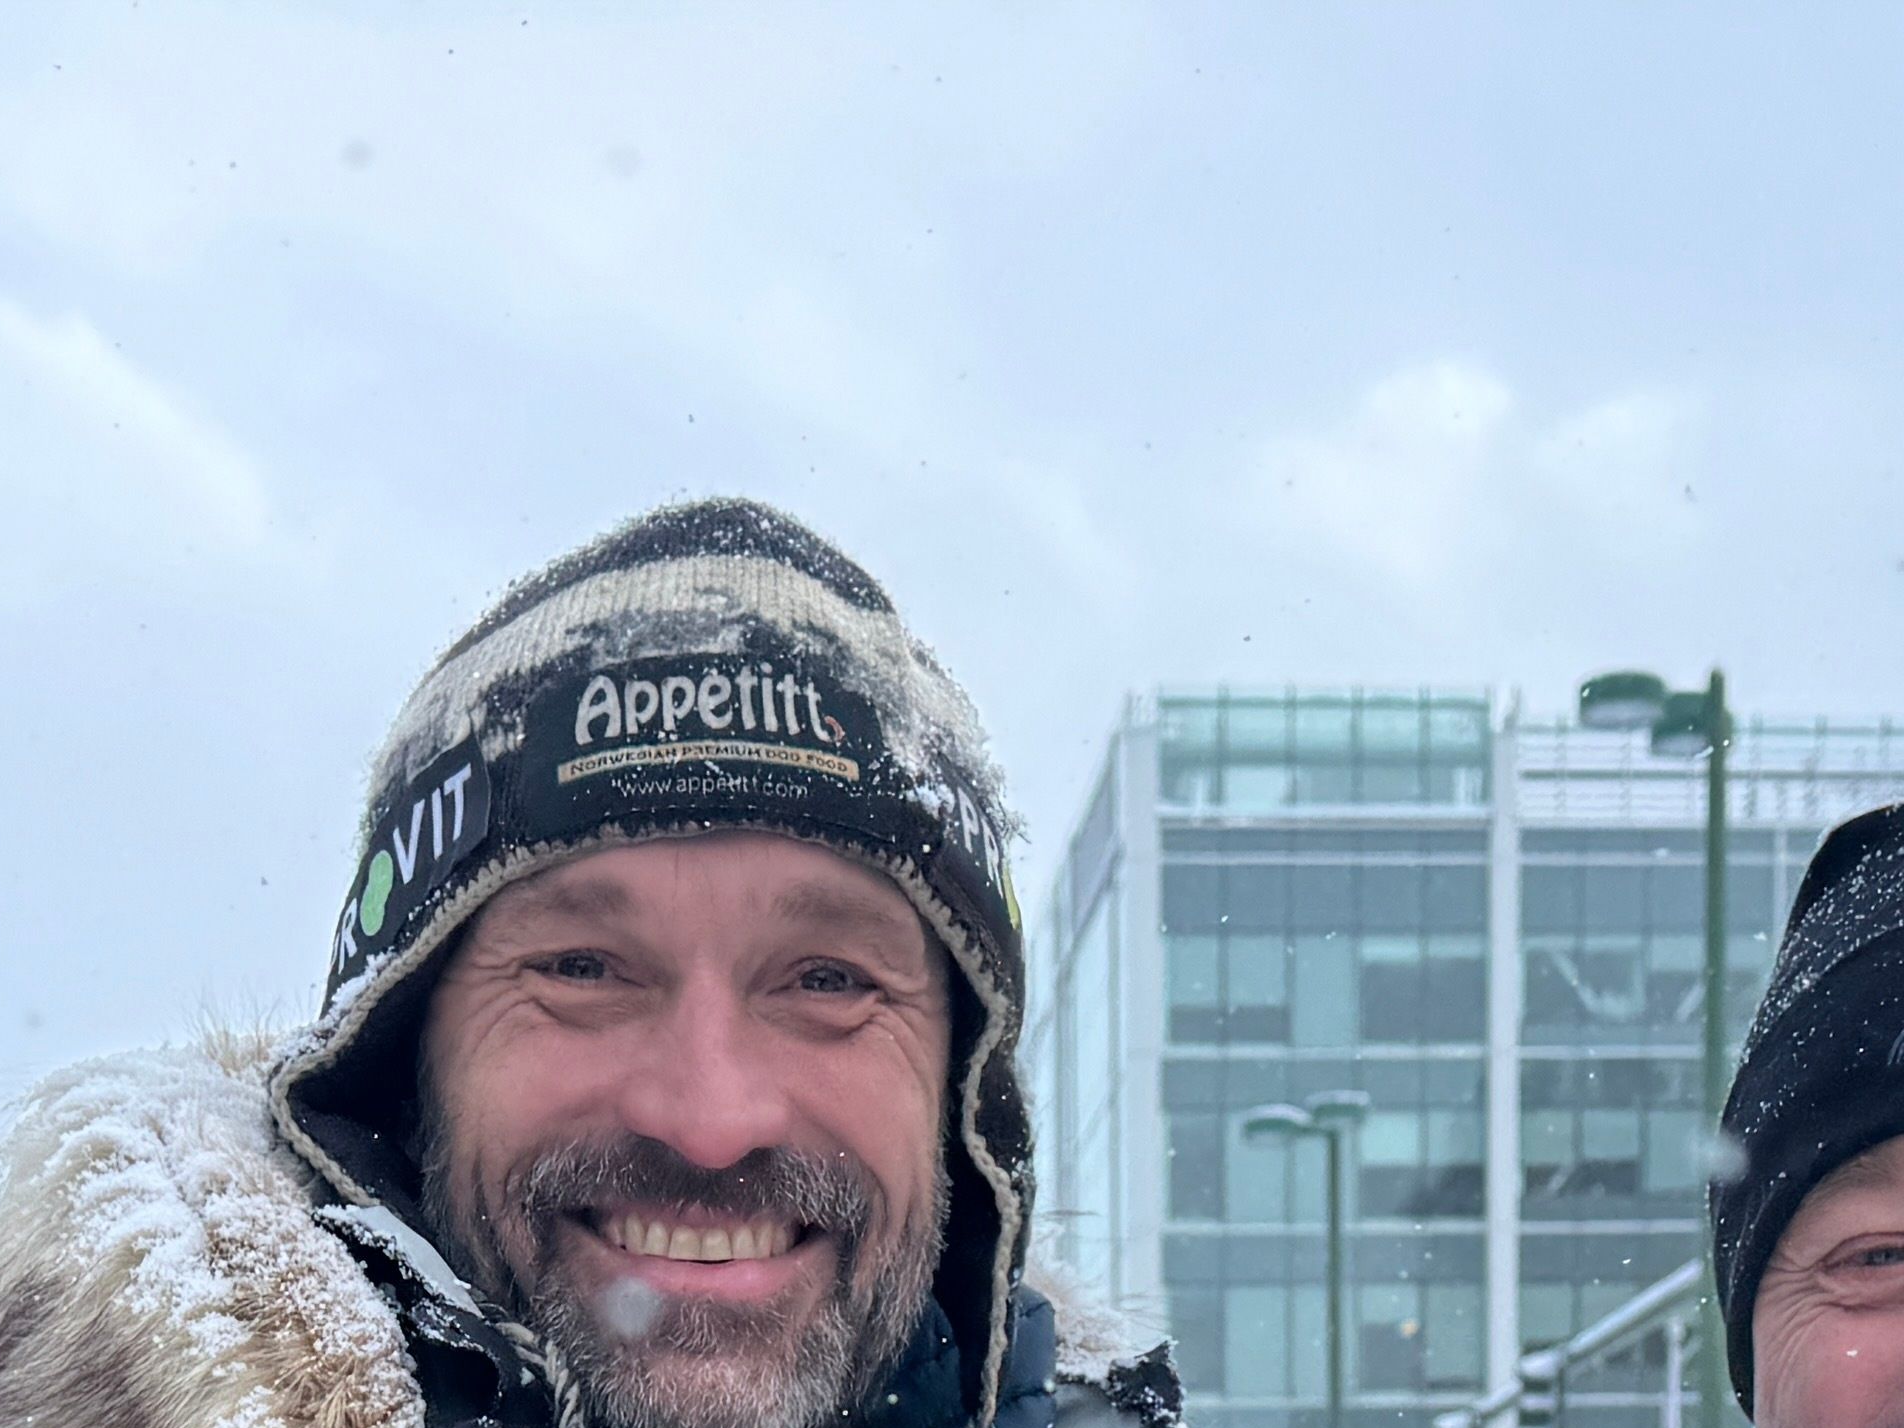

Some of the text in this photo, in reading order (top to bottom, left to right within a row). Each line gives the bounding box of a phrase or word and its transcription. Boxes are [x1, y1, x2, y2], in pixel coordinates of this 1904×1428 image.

[575, 662, 845, 745] Appetitt
[570, 745, 848, 775] NORWEGIAN PREMIUM DOG FOOD
